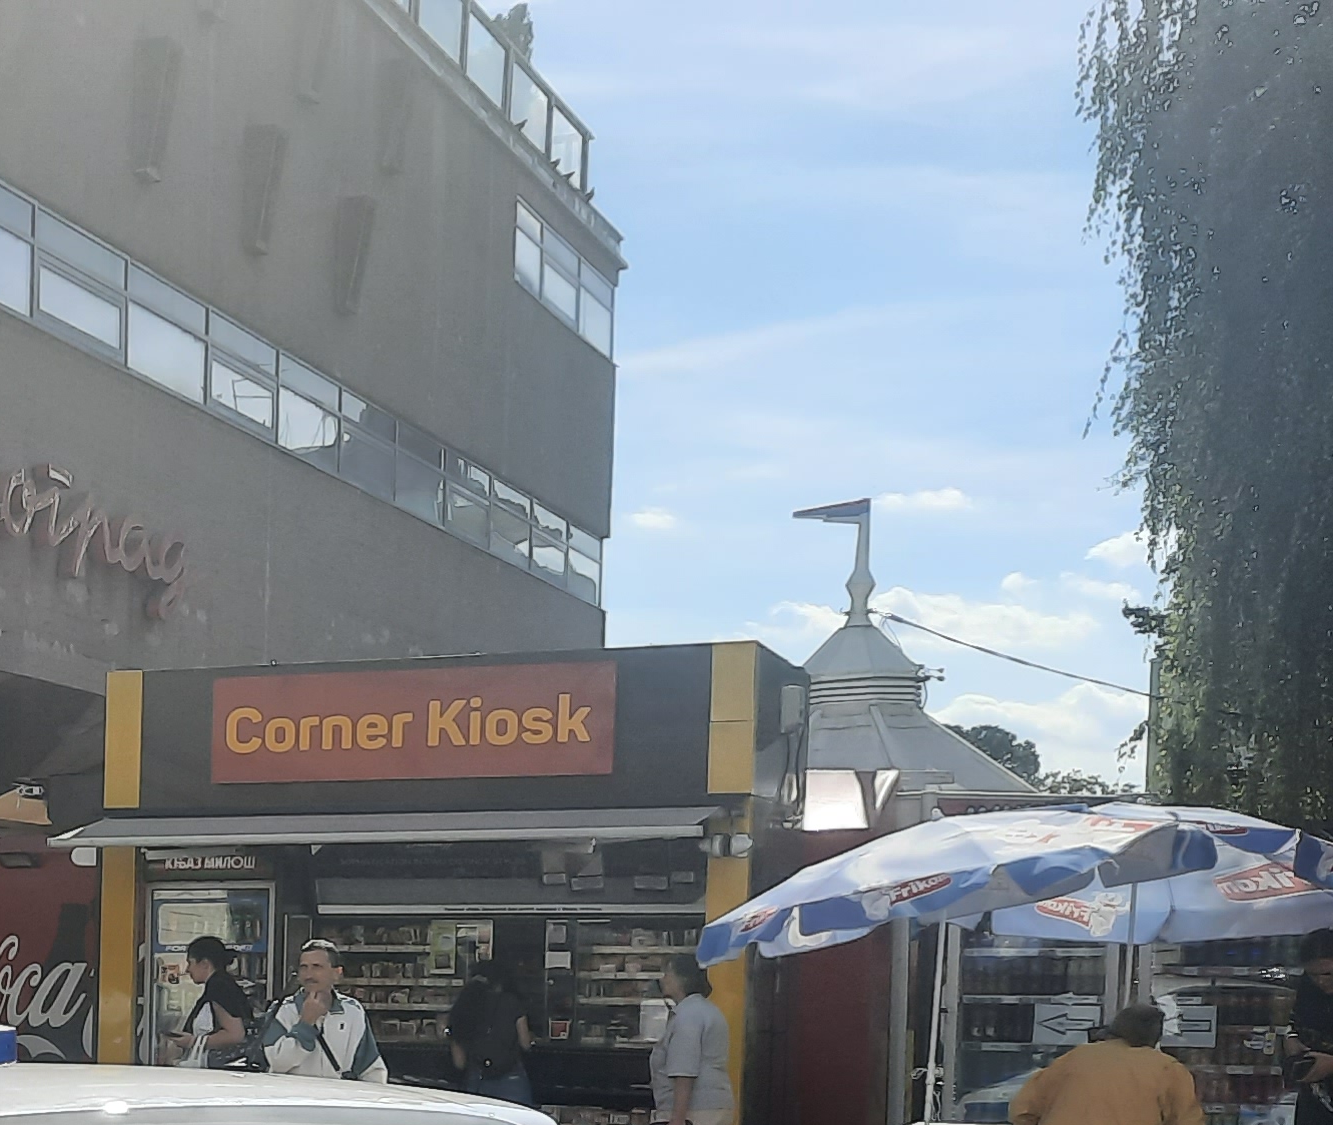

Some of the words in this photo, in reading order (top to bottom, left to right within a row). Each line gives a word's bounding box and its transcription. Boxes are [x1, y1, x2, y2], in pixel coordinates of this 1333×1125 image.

[225, 706, 414, 754] Corner
[426, 694, 592, 748] Kiosk
[164, 856, 202, 870] КЊАЗ
[203, 856, 255, 870] МИЛОШ
